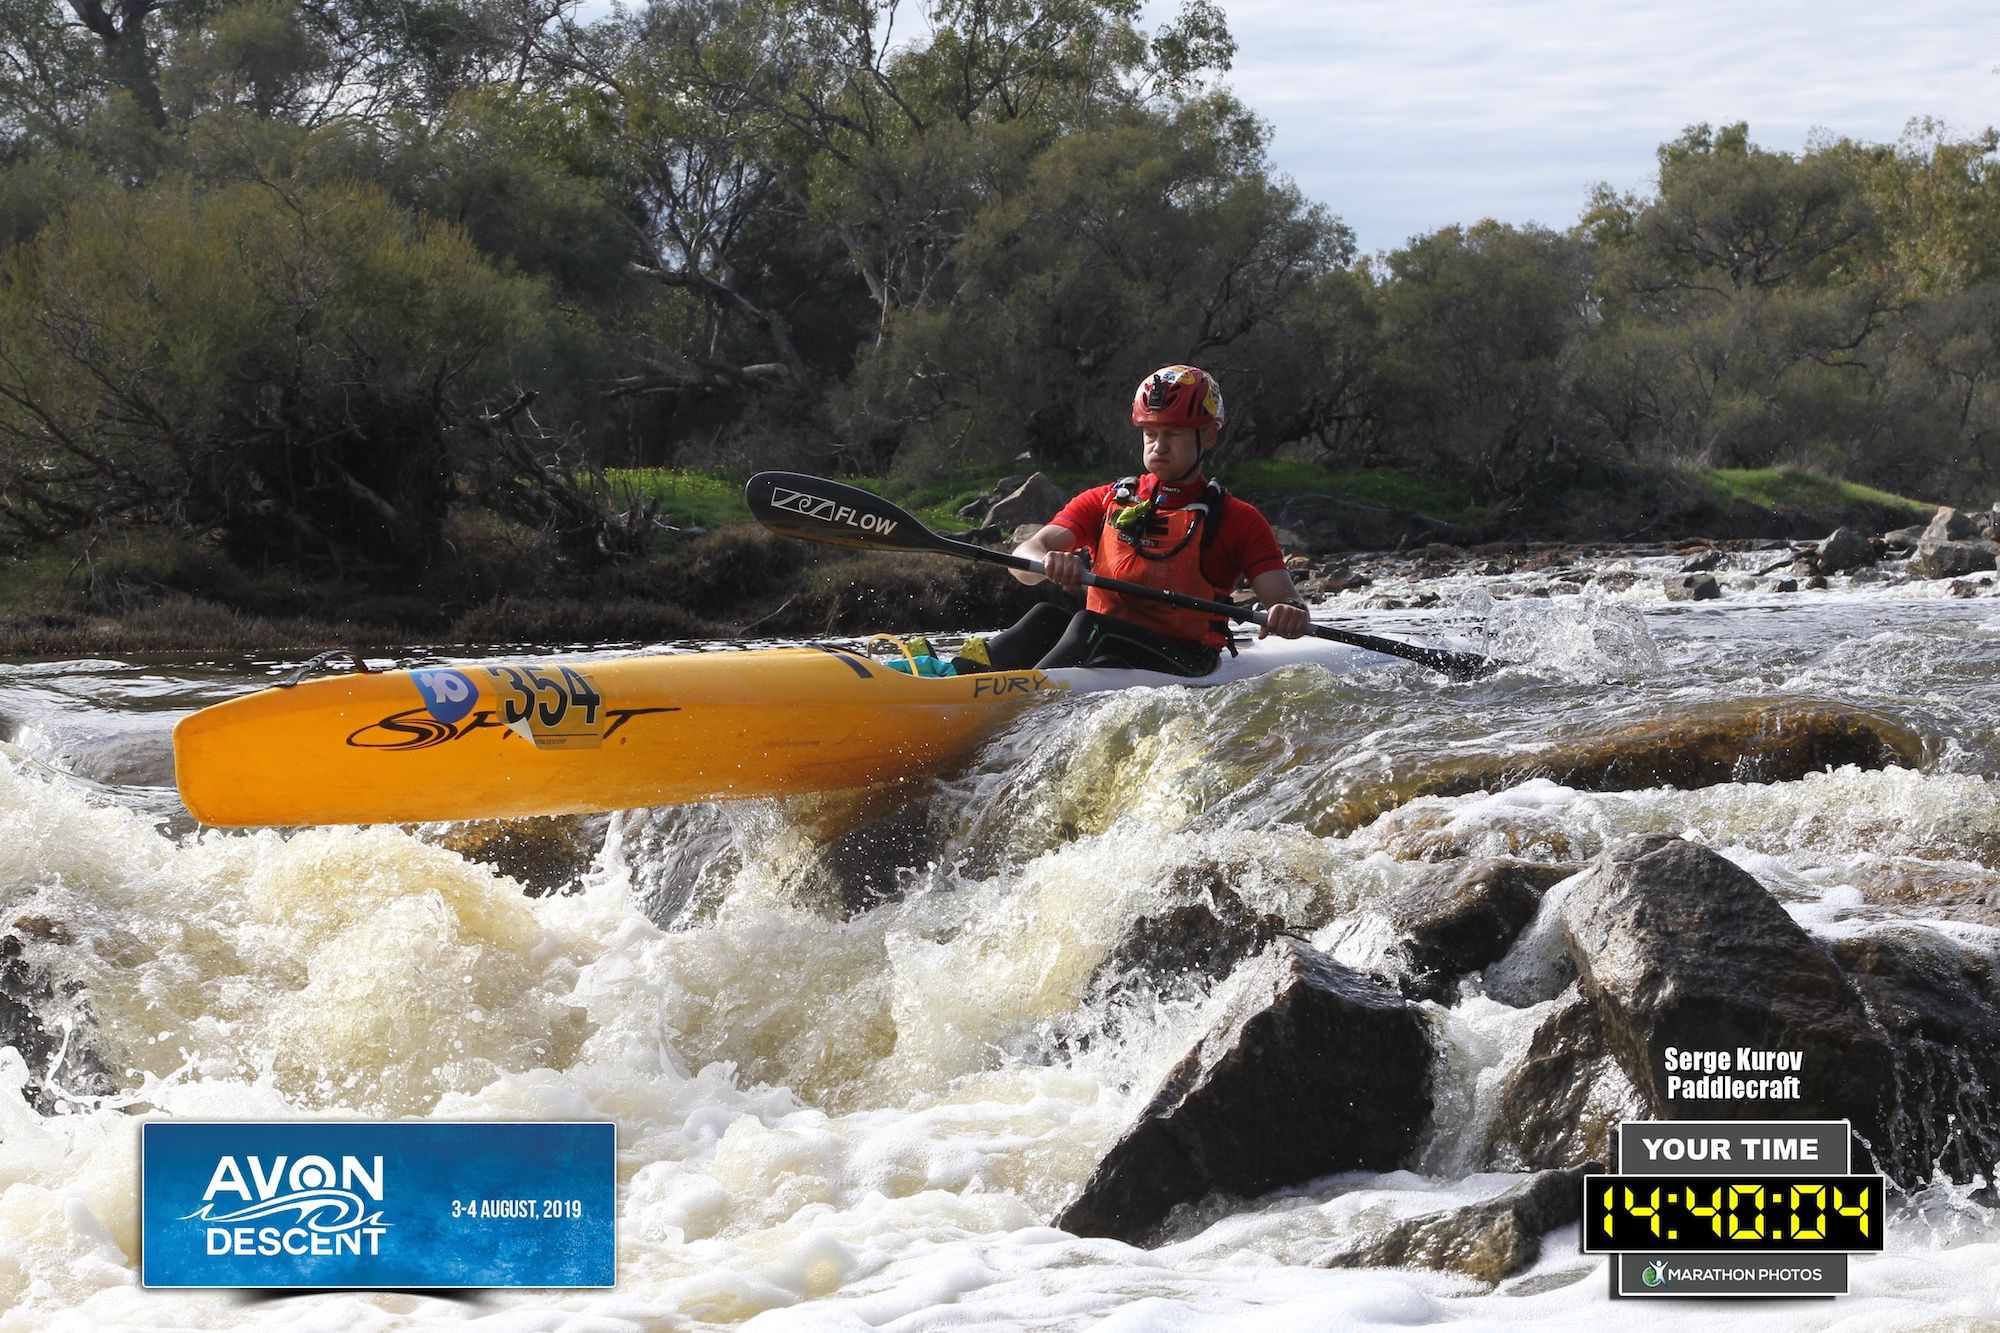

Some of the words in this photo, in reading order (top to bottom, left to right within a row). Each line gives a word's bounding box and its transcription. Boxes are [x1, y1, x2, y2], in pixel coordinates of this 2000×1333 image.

[834, 505, 898, 536] FLOW
[485, 664, 601, 728] 354
[973, 675, 1048, 698] FURY
